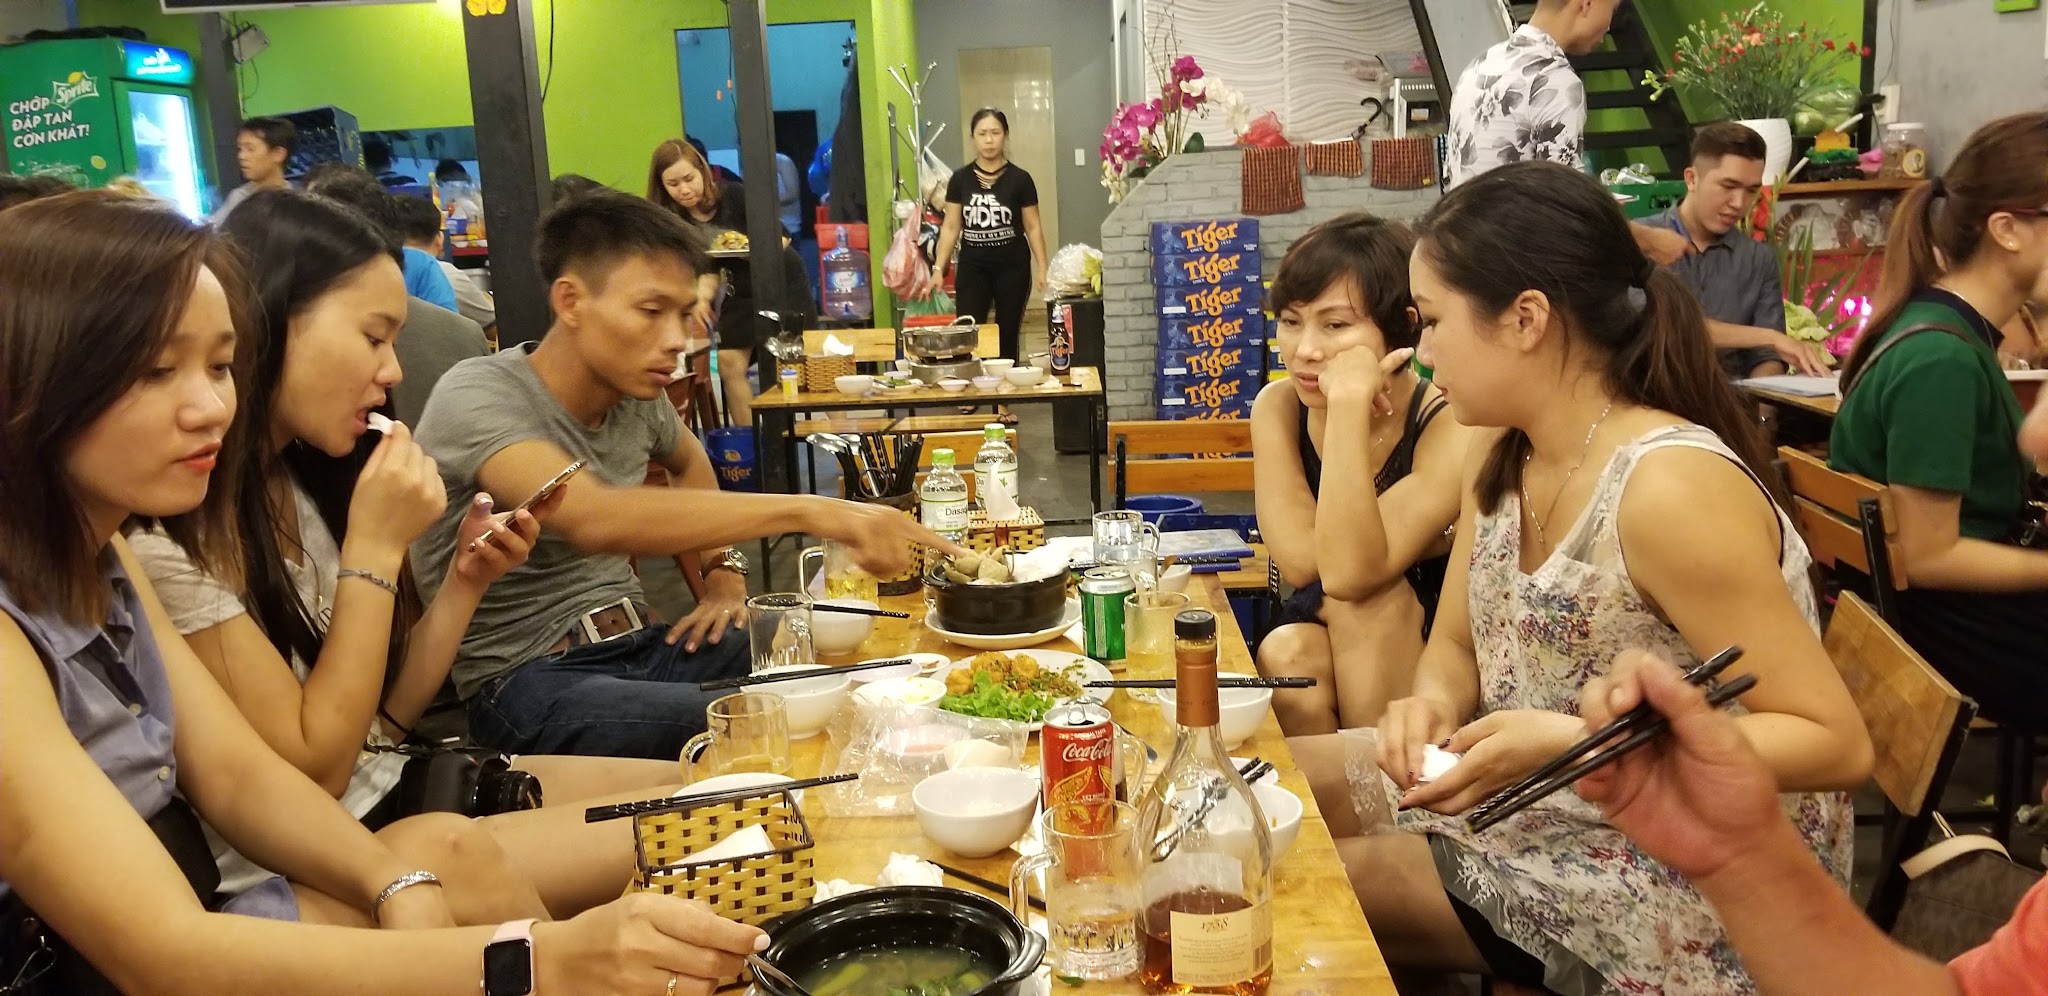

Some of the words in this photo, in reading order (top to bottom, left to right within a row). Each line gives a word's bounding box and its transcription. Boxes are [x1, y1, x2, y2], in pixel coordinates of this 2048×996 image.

[57, 80, 92, 104] Sprite
[43, 109, 72, 126] TAN
[48, 123, 90, 142] KHÁT!
[969, 193, 1000, 206] THE
[1181, 220, 1238, 252] Tiger
[1183, 252, 1240, 284] Tiger
[1185, 285, 1242, 316] Tiger
[1187, 317, 1243, 348] Tiger
[1186, 347, 1242, 377] Tiger
[1184, 378, 1240, 408] Tiger
[720, 466, 752, 482] Tiger
